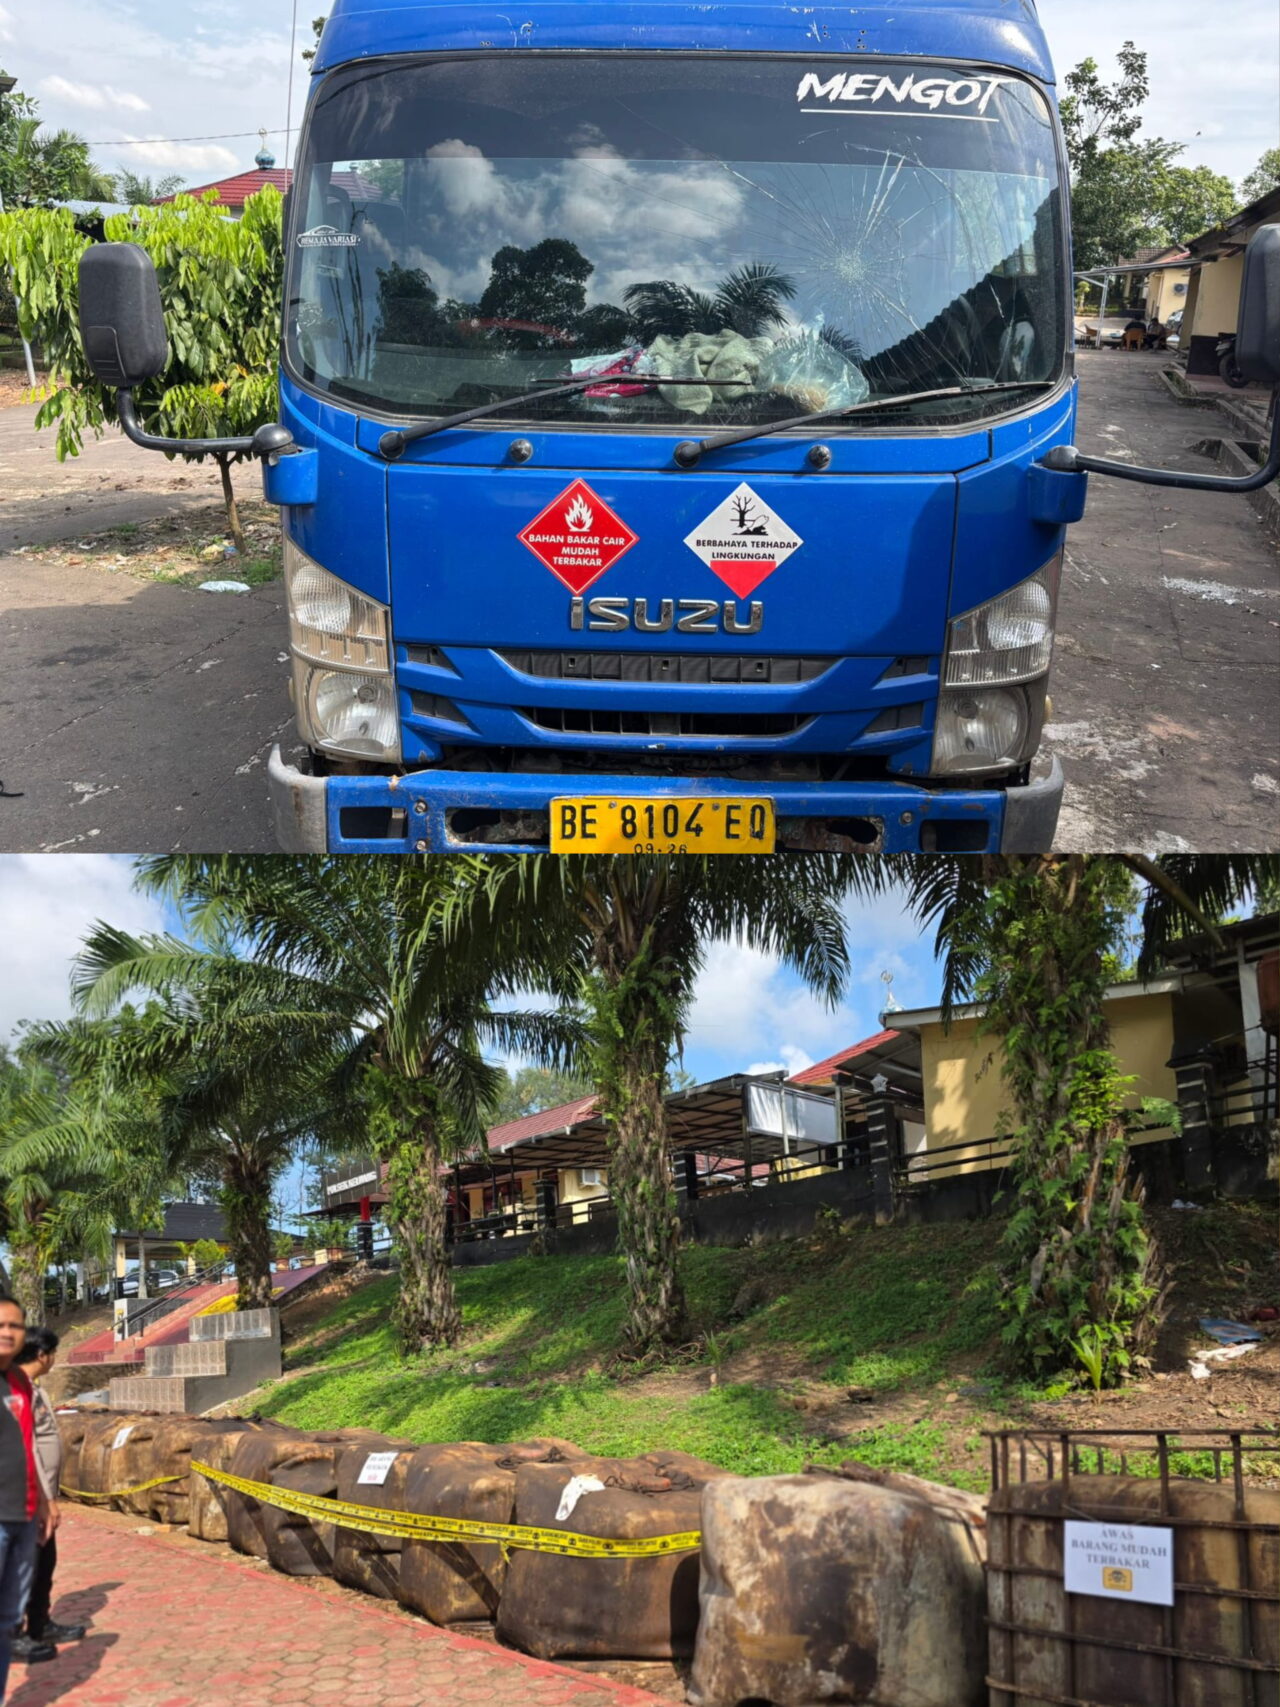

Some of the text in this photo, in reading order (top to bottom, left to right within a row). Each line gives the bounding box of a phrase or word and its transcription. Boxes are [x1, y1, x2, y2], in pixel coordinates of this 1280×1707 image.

[797, 72, 1018, 114] MENGOT
[528, 534, 625, 546] BAHAN BAKAR CAIR
[695, 539, 798, 550] BERBAHAYA TERHADAP
[561, 546, 599, 556] MUDAH
[711, 551, 775, 561] LINGKUNGAN
[552, 556, 603, 567] TERBAKAR
[570, 596, 763, 634] ISUZU
[560, 803, 597, 840] BE
[620, 802, 704, 840] 8104
[1100, 1528, 1135, 1540] AWAS
[1071, 1539, 1168, 1557] BARANG MUDAH
[1086, 1553, 1150, 1569] TERBAKAR
